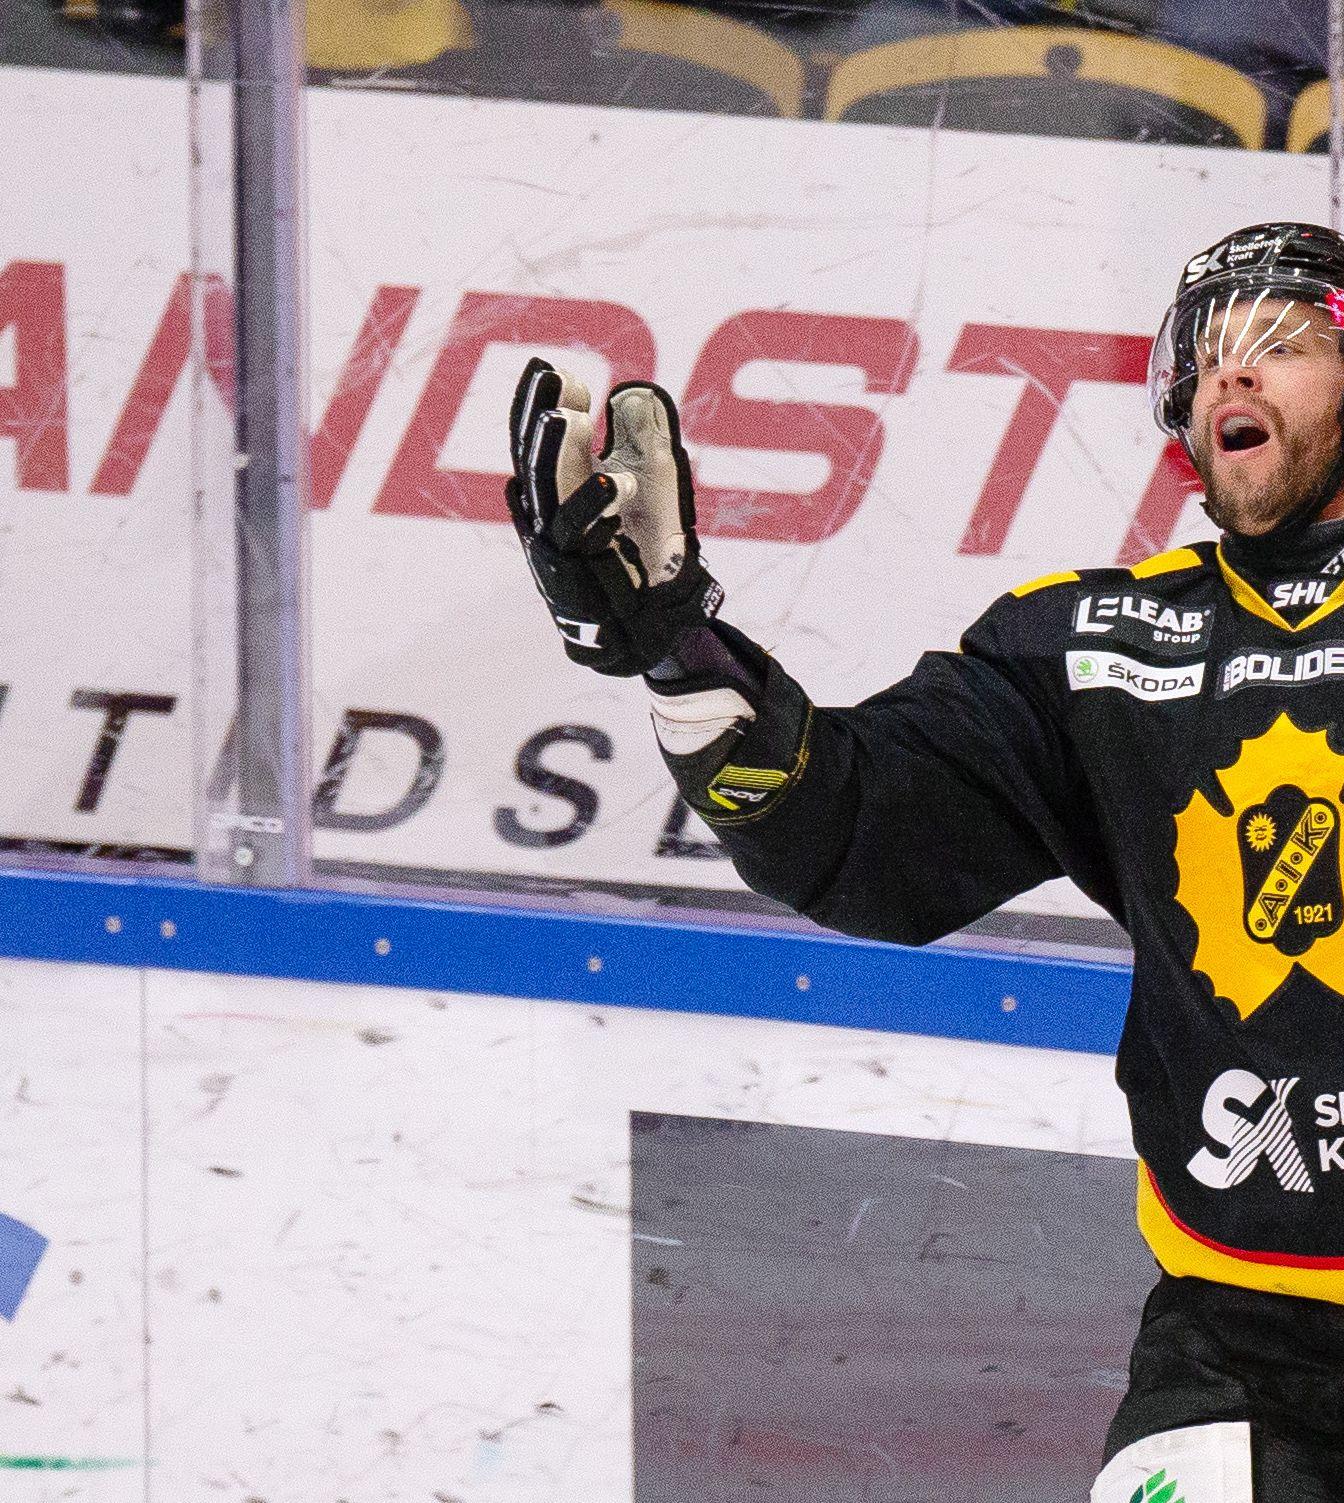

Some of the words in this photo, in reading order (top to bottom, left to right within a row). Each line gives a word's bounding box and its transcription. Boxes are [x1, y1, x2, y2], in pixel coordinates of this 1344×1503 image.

[1272, 581, 1331, 609] SHL
[1121, 596, 1204, 633] LEAB
[1152, 630, 1201, 644] group
[1107, 661, 1196, 693] ŠKODA
[1293, 902, 1334, 926] 1921
